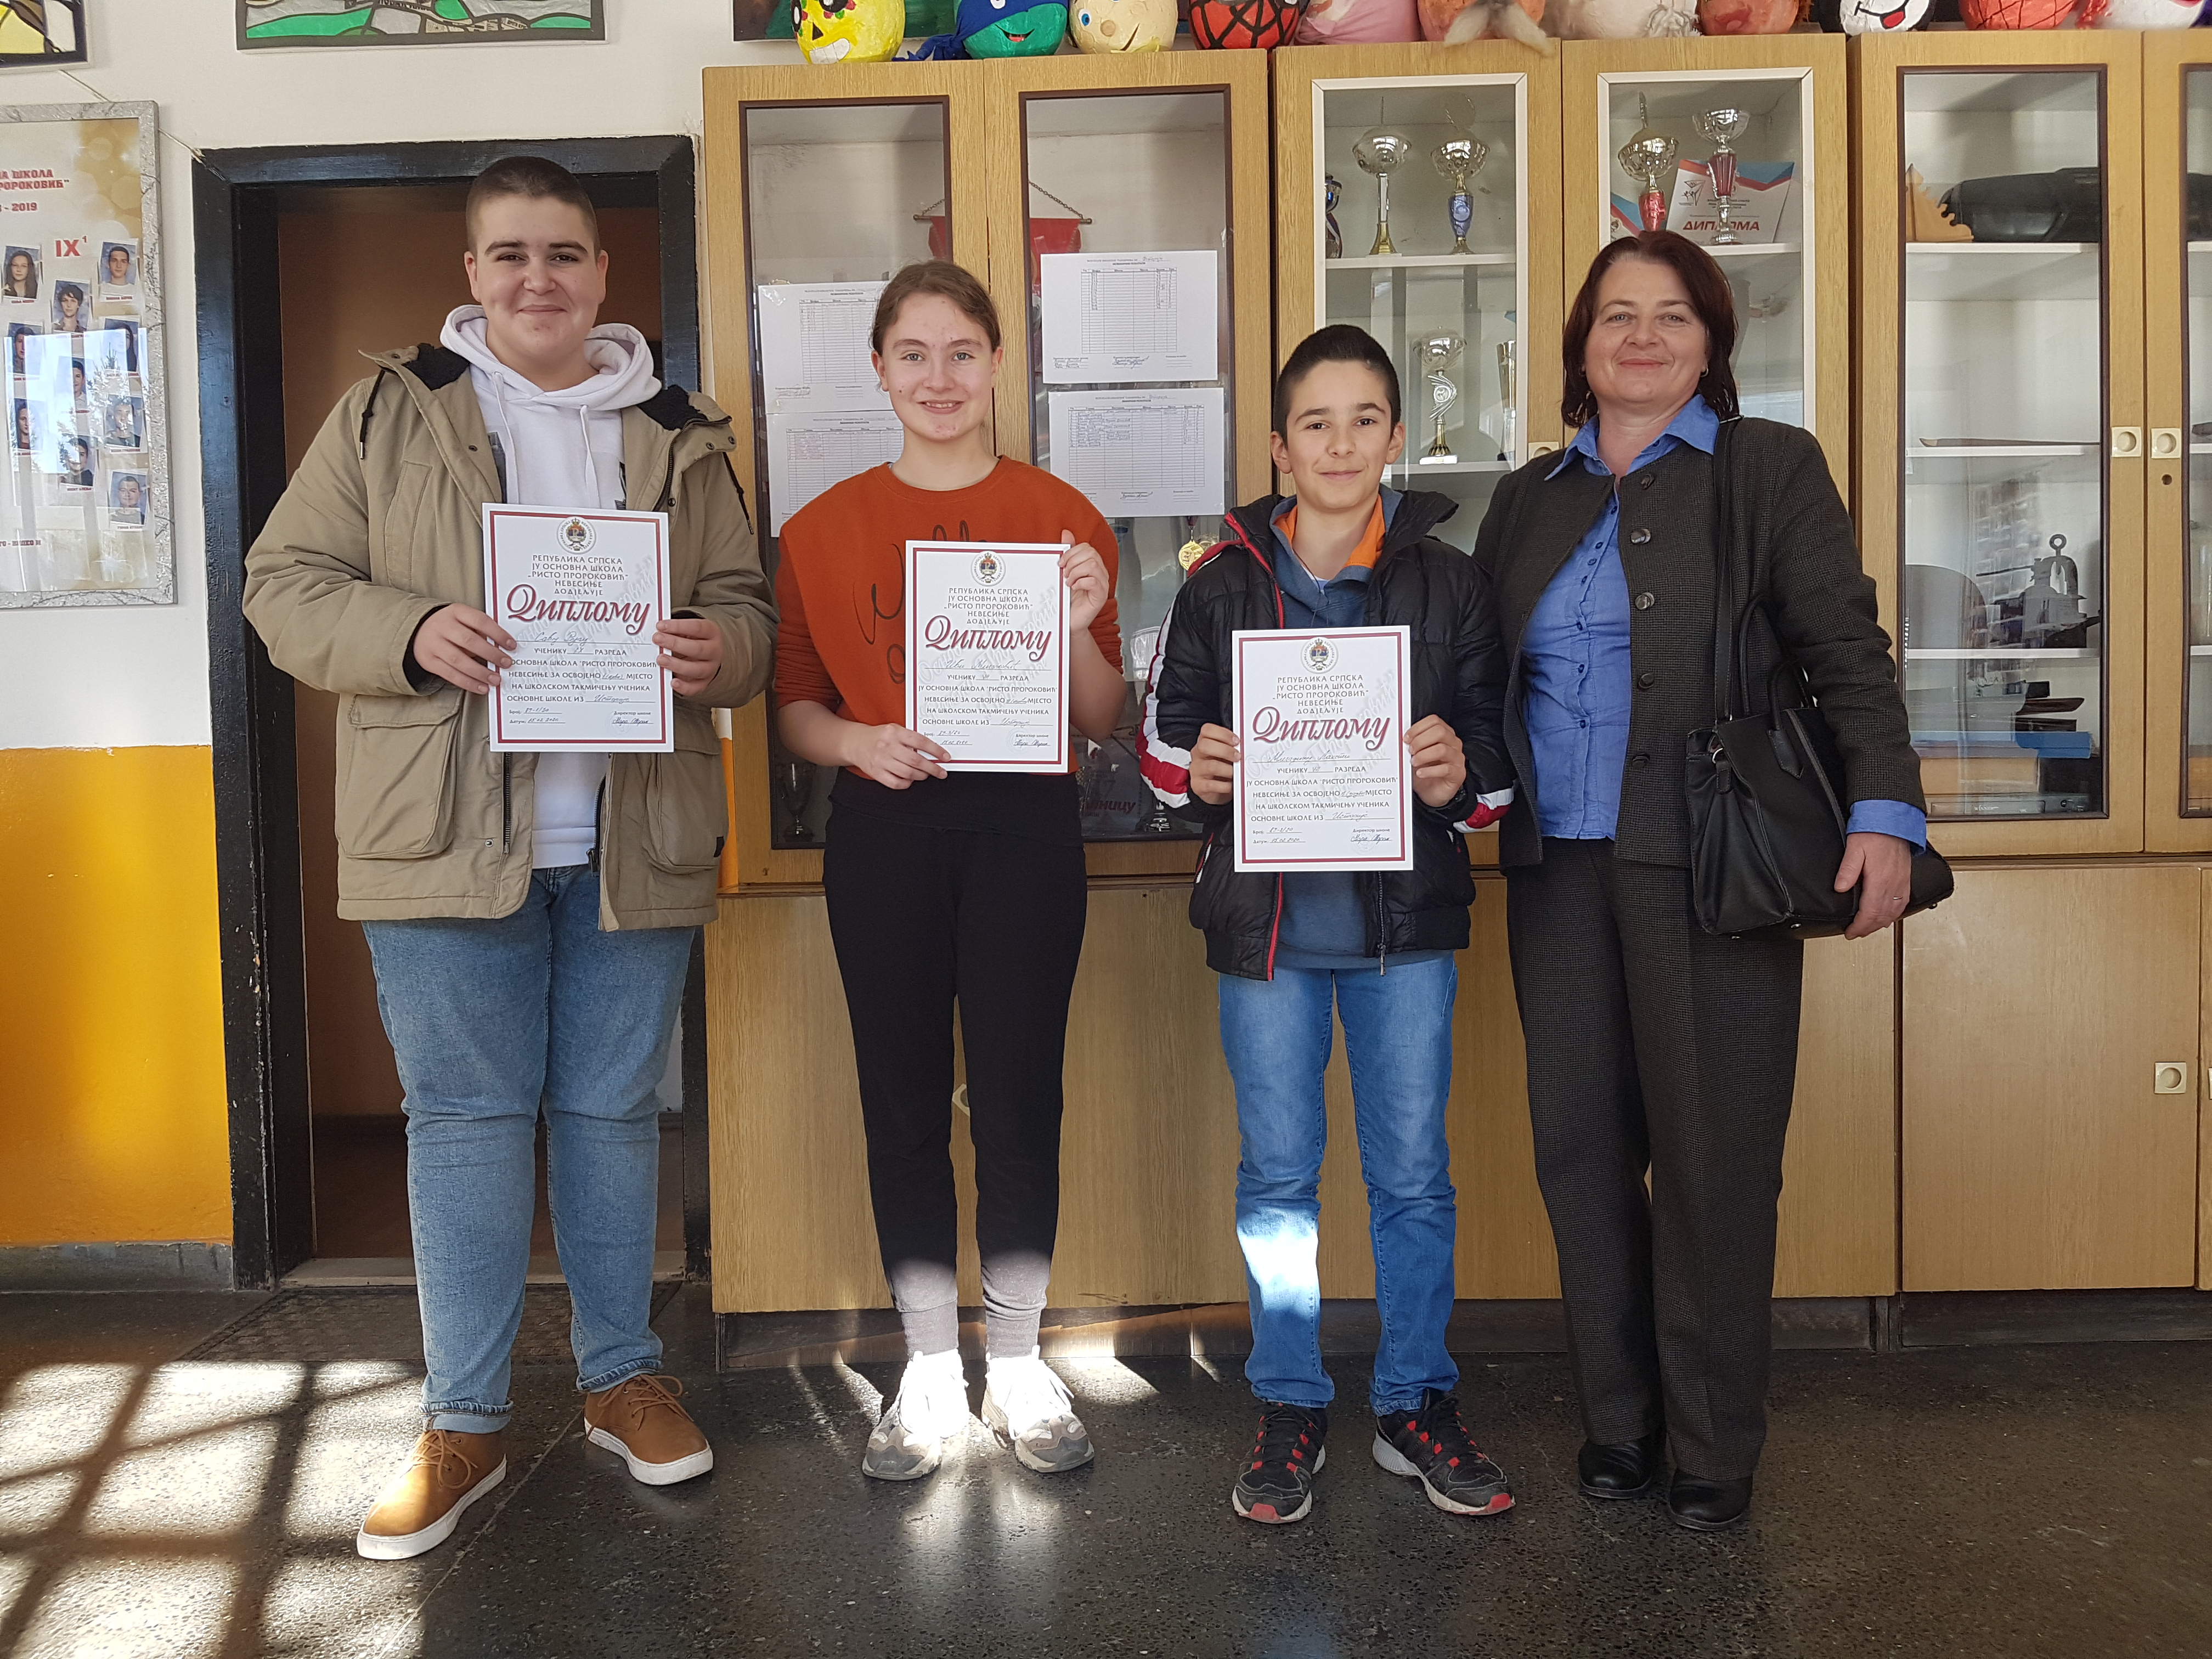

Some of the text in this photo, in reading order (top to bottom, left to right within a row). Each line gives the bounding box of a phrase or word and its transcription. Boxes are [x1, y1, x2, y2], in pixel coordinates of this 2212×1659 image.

[12, 169, 54, 179] ШКОЛА
[12, 202, 37, 211] 2019
[1683, 221, 1760, 231] ДИПМА
[507, 584, 651, 635] Диплому
[925, 615, 1052, 662] Диплому
[1252, 706, 1390, 751] Диплому
